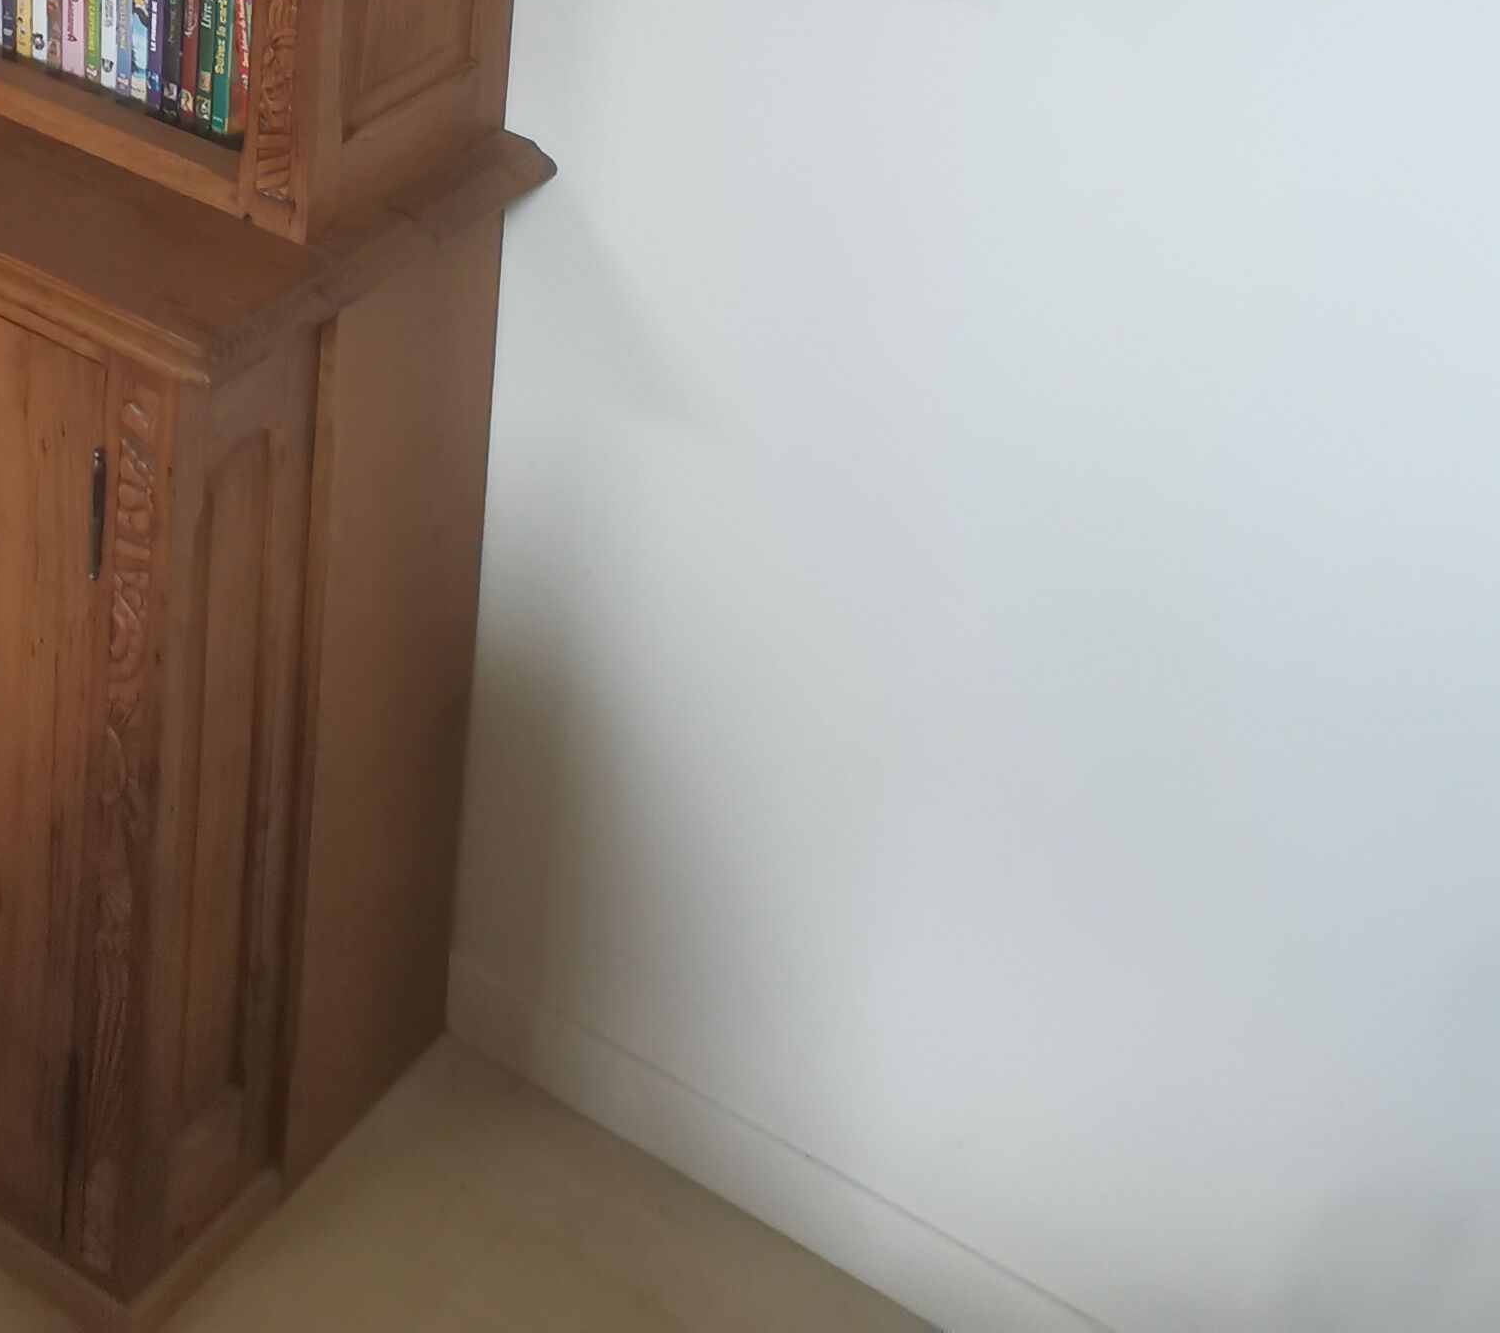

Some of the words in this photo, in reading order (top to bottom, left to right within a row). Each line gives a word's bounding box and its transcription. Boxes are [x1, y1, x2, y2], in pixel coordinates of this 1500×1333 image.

[151, 0, 158, 13] DE
[200, 0, 213, 29] Livre
[216, 26, 226, 38] la
[150, 40, 157, 52] LE
[214, 40, 226, 75] Suivez
